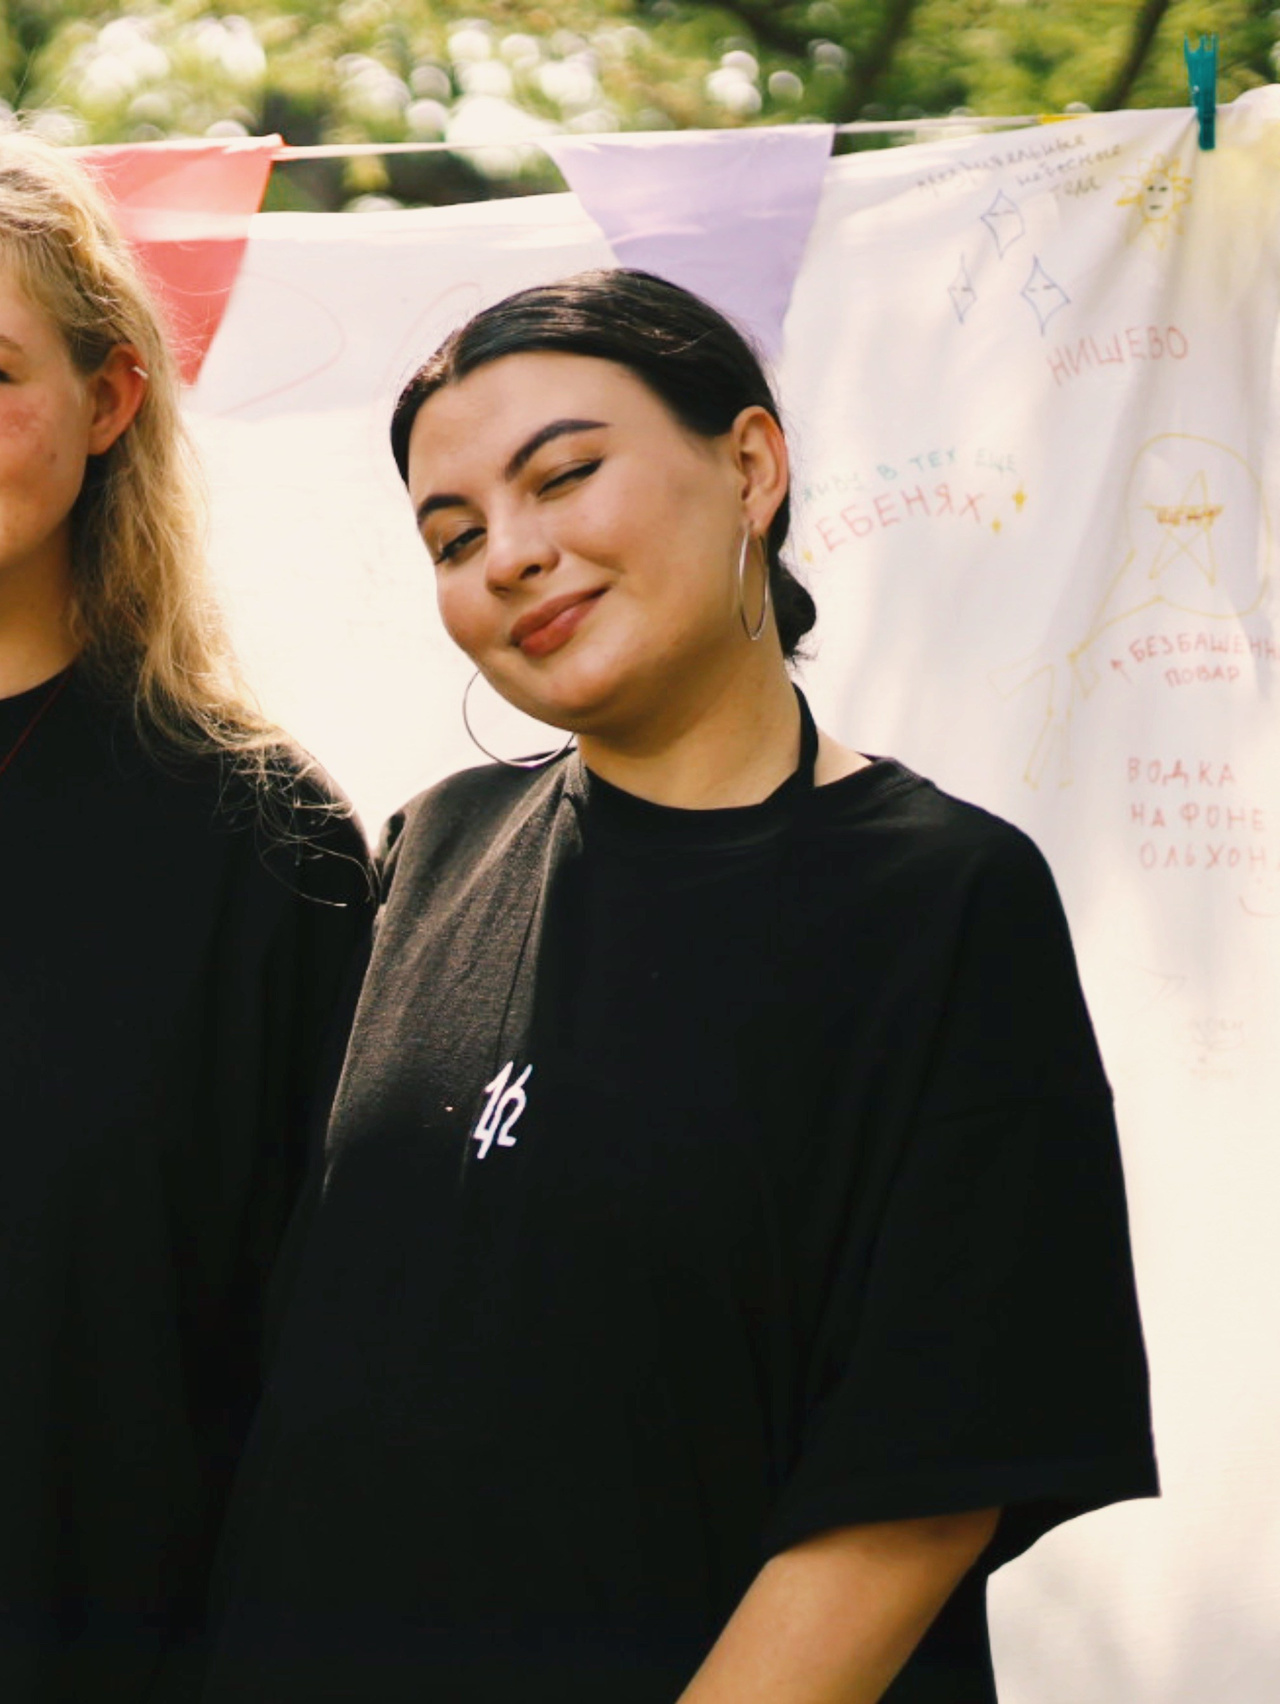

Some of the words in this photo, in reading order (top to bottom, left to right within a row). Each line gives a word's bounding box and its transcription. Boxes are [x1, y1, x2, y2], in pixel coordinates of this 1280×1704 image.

[1046, 325, 1189, 387] НИШЕВО
[814, 481, 985, 554] ЕБЕНЯХ
[1164, 663, 1241, 689] ПОВАР
[1126, 754, 1236, 789] ВОДКА
[1129, 801, 1167, 829] НА
[1178, 800, 1265, 832] ФОНЕ
[1138, 838, 1280, 873] ОЛЬХОН
